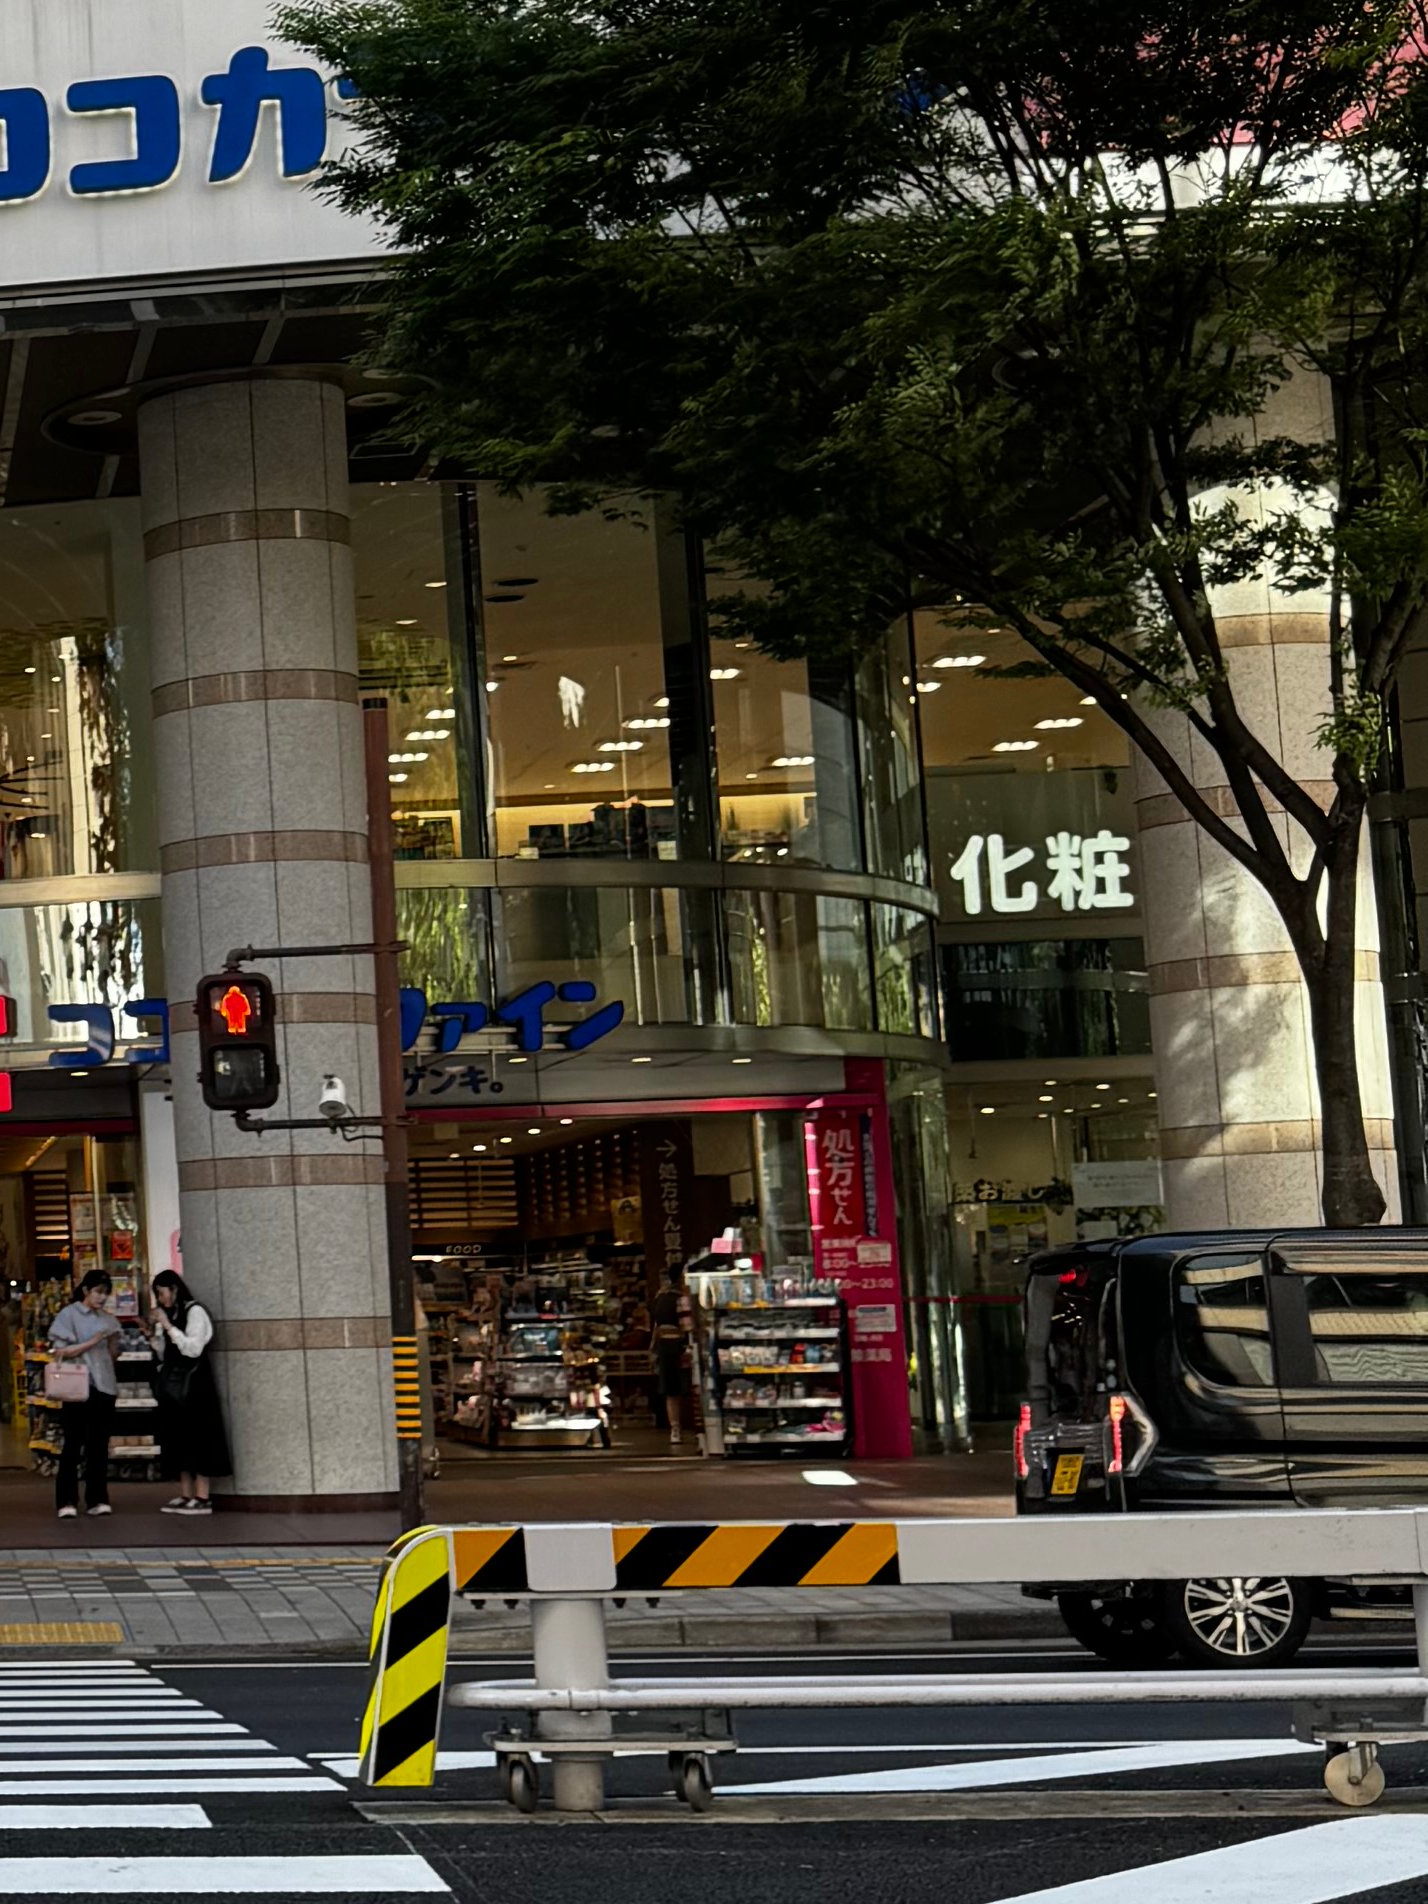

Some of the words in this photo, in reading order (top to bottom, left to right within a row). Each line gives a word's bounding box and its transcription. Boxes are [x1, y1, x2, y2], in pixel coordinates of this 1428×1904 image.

[950, 829, 1134, 915] 化粧
[822, 1128, 855, 1225] 処方せん
[445, 1244, 482, 1254] FOOD
